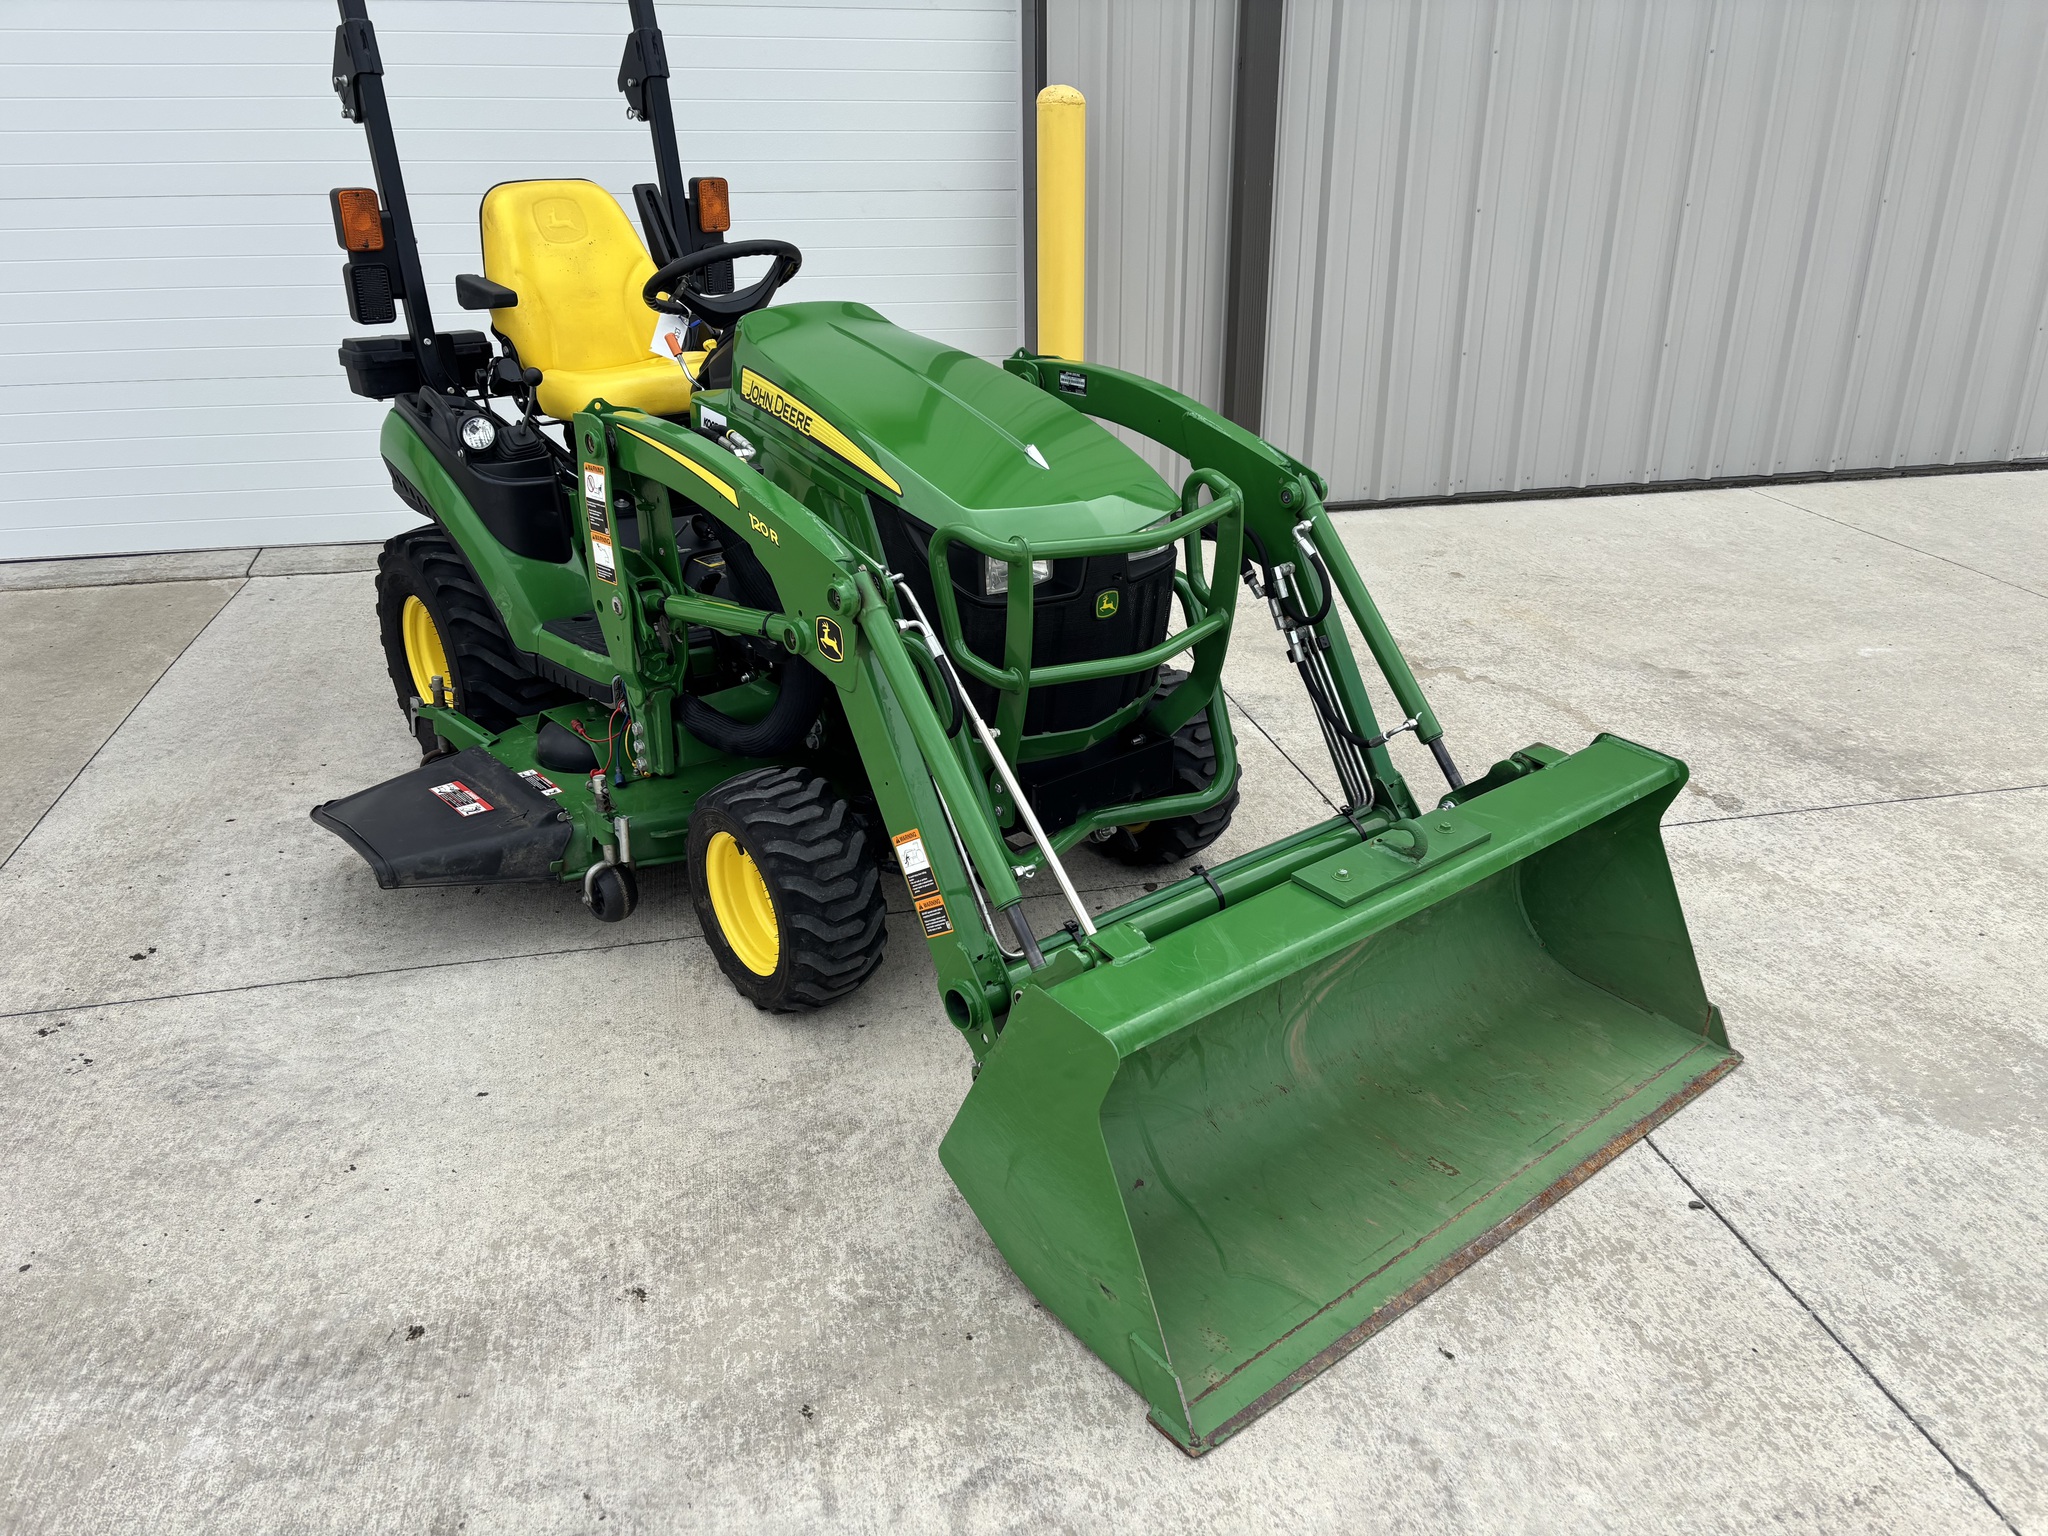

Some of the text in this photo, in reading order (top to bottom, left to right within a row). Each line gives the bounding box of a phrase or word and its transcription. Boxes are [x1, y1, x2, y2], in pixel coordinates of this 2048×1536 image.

[746, 380, 814, 434] JOHN DEERE
[900, 832, 917, 842] WARNING
[923, 899, 941, 908] WARNING
